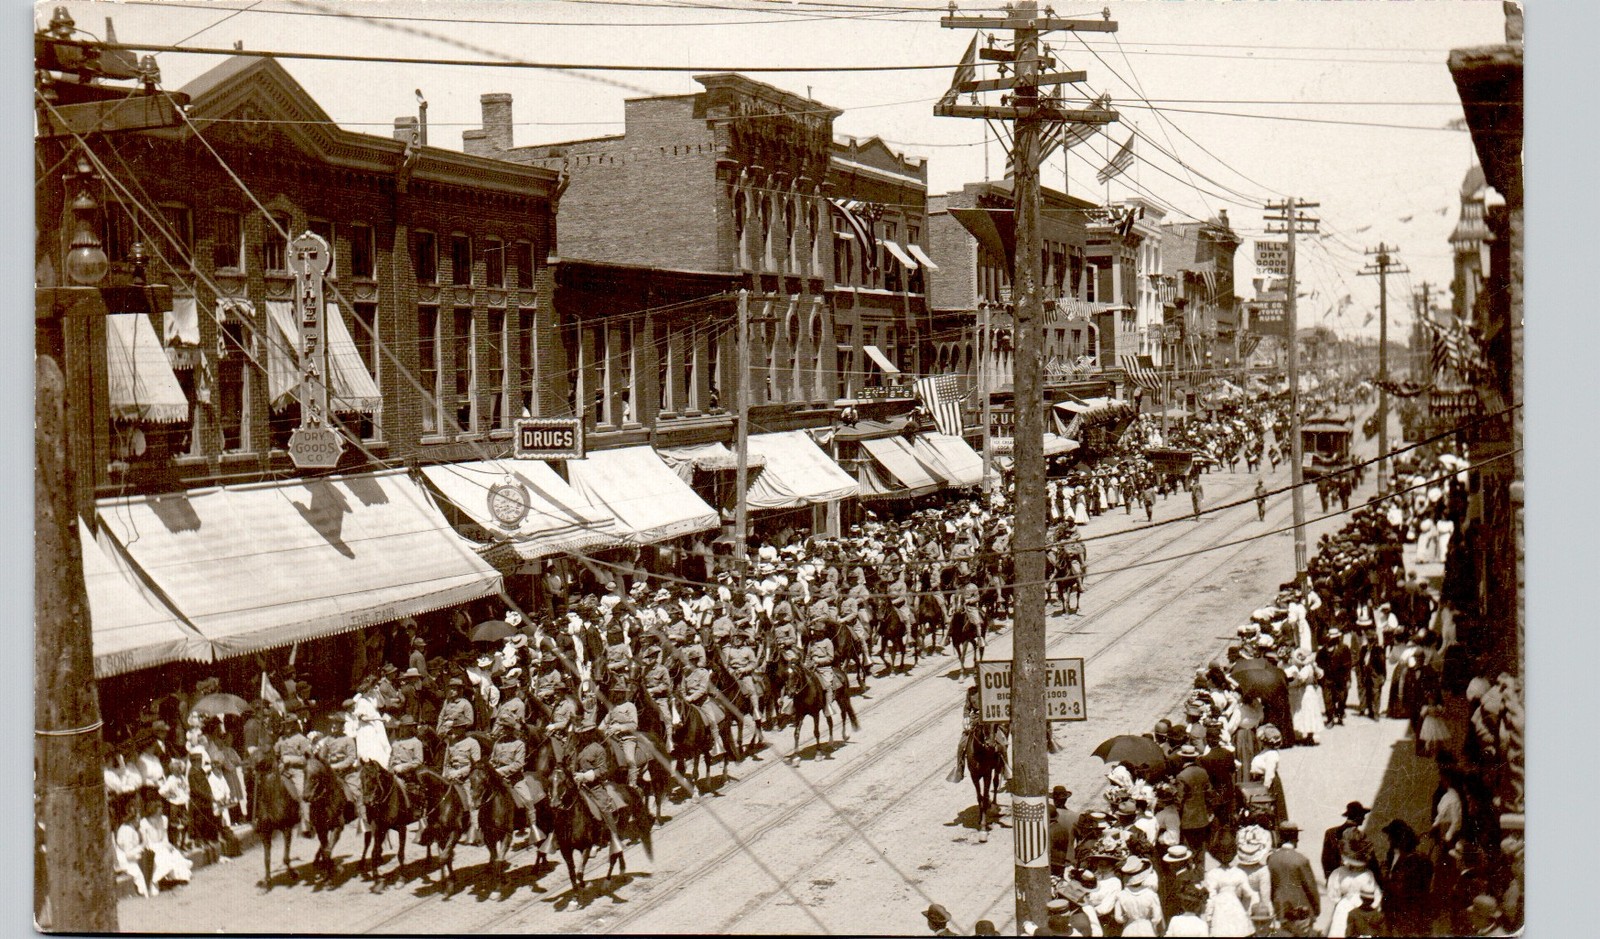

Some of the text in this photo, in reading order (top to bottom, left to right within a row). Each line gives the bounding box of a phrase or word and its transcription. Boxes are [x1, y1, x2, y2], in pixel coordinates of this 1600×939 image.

[304, 432, 325, 442] DRY
[523, 430, 573, 447] DRUGS
[295, 442, 335, 454] GOODS
[306, 453, 323, 463] CO
[350, 607, 396, 626] THE FAIR
[1045, 669, 1077, 687] FAIR
